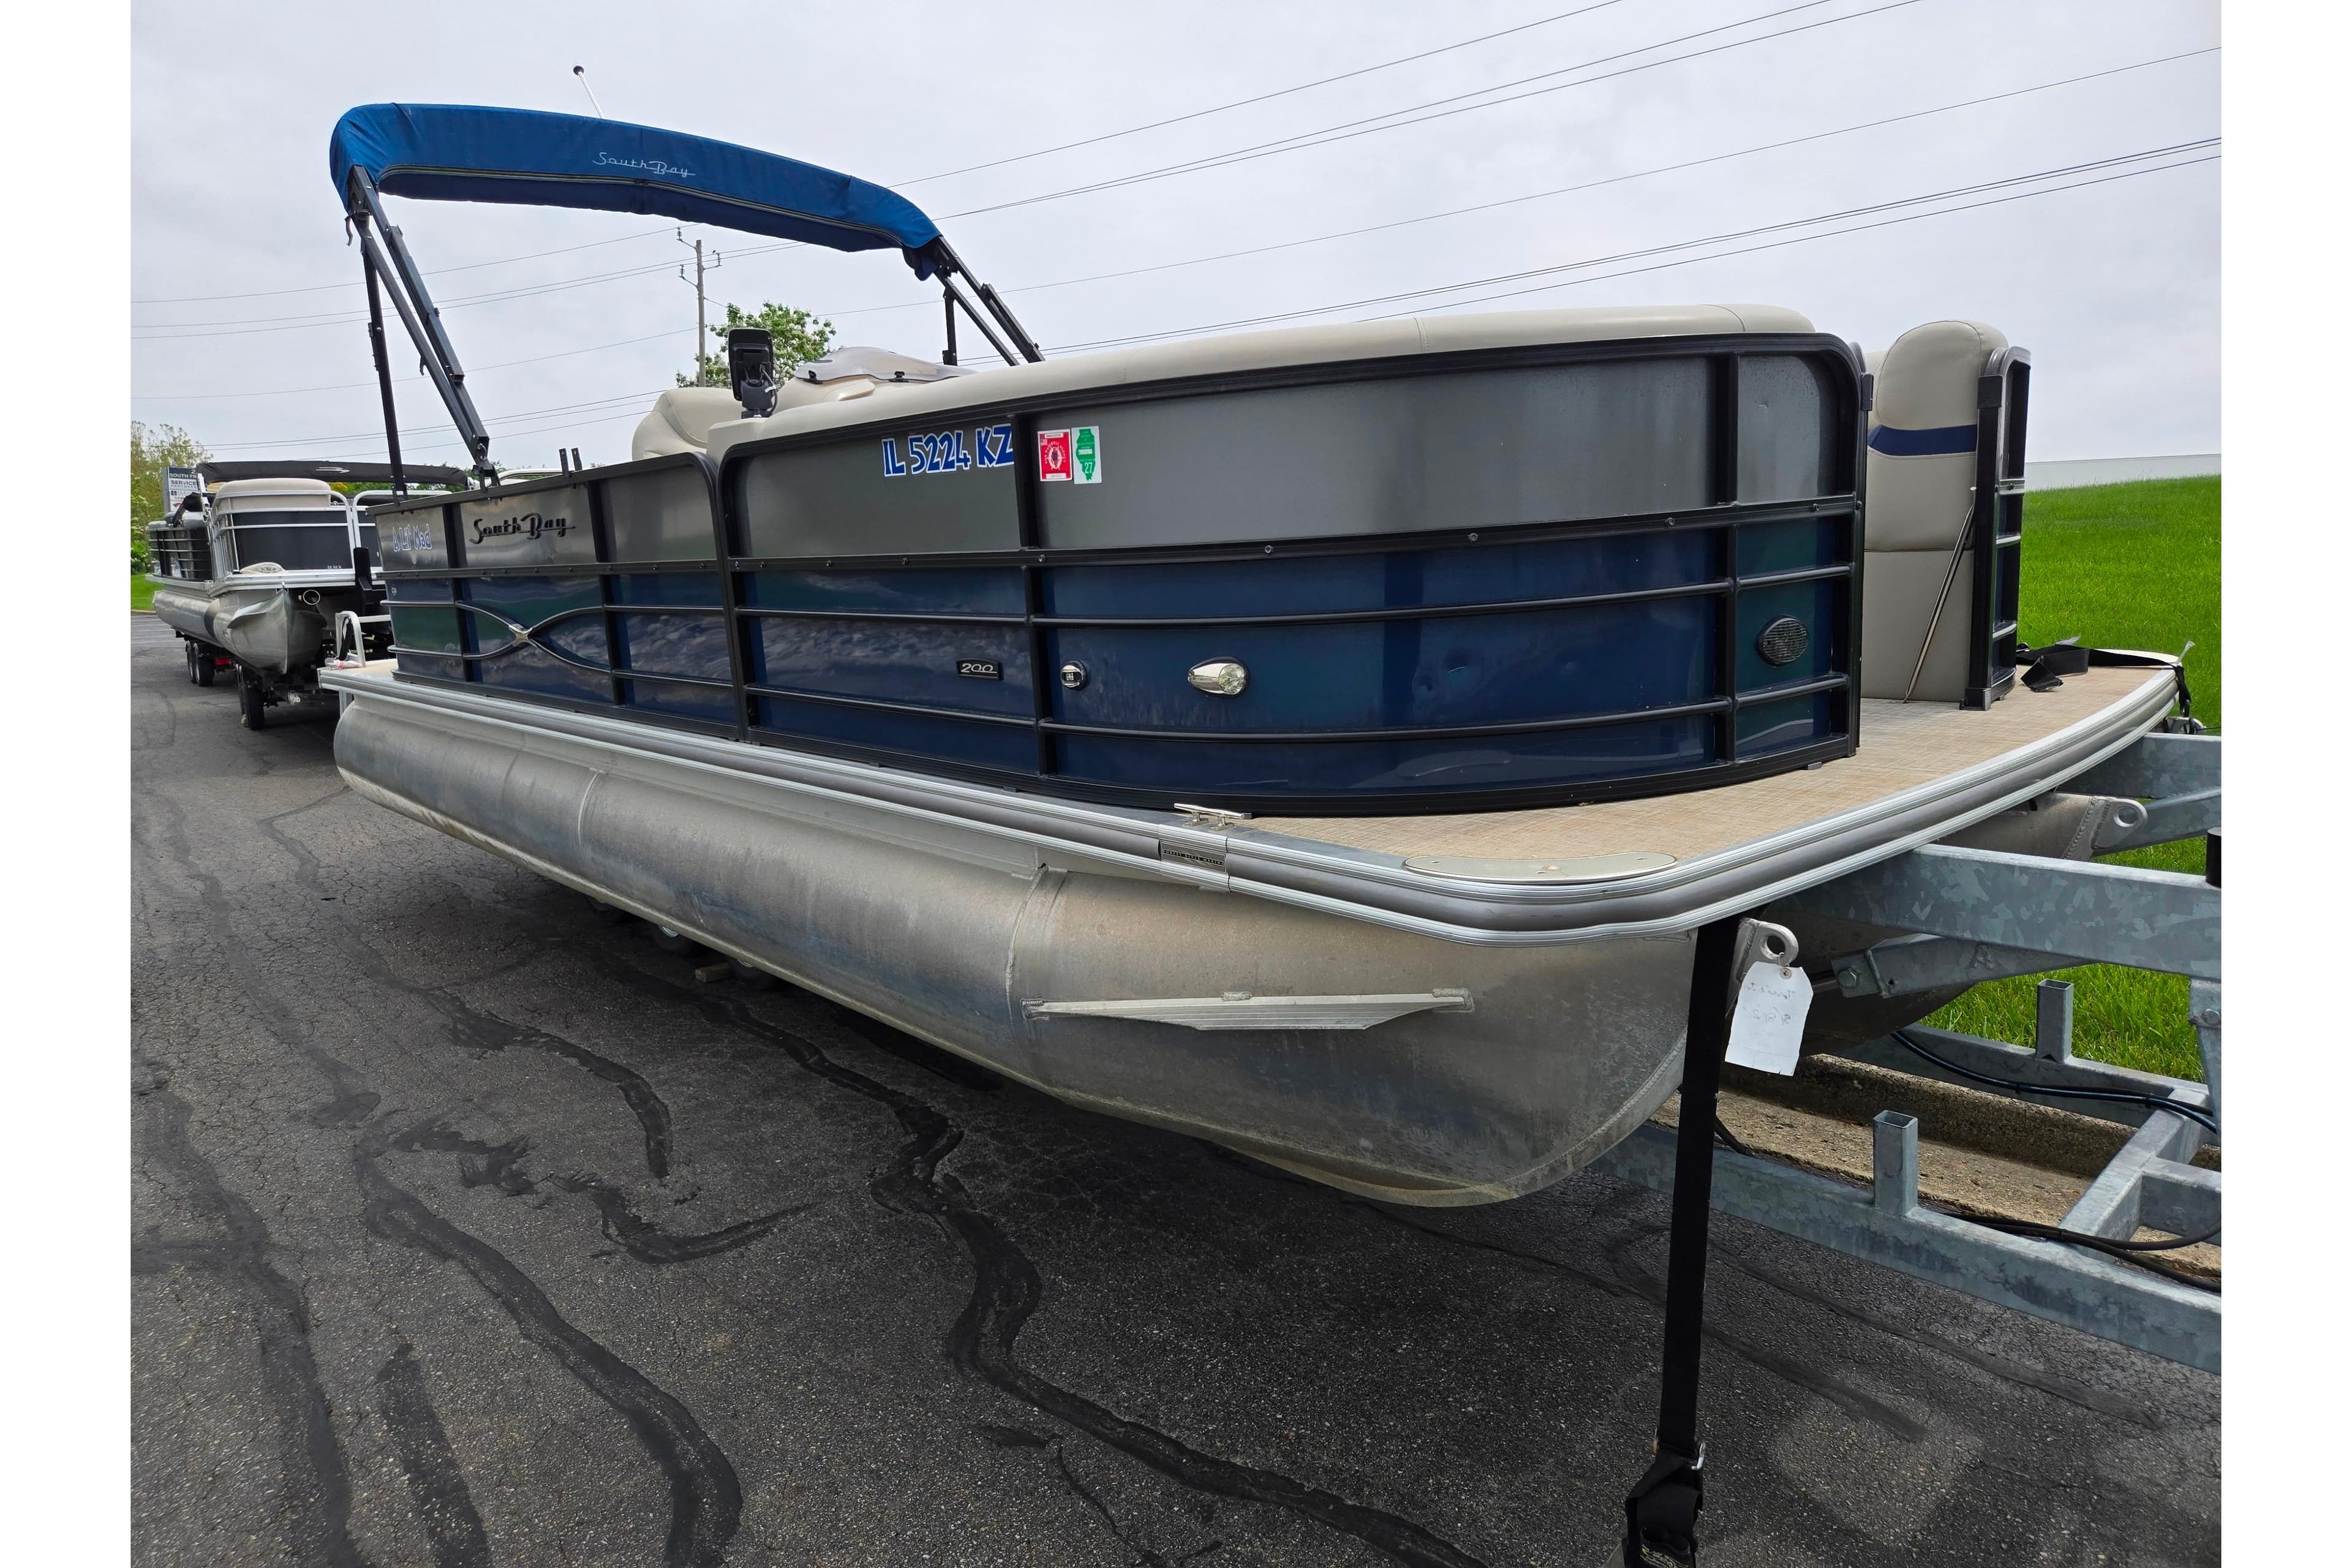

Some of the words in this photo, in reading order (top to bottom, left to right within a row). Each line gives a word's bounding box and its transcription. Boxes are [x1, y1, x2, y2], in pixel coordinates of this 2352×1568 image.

[882, 437, 907, 477] IL
[908, 430, 971, 475] 5224
[976, 423, 1015, 468] KZ
[1084, 462, 1093, 474] 27
[393, 526, 401, 552] A
[413, 523, 432, 551] Mad
[469, 516, 522, 545] South
[521, 512, 576, 540] Bay
[960, 663, 997, 673] 200
